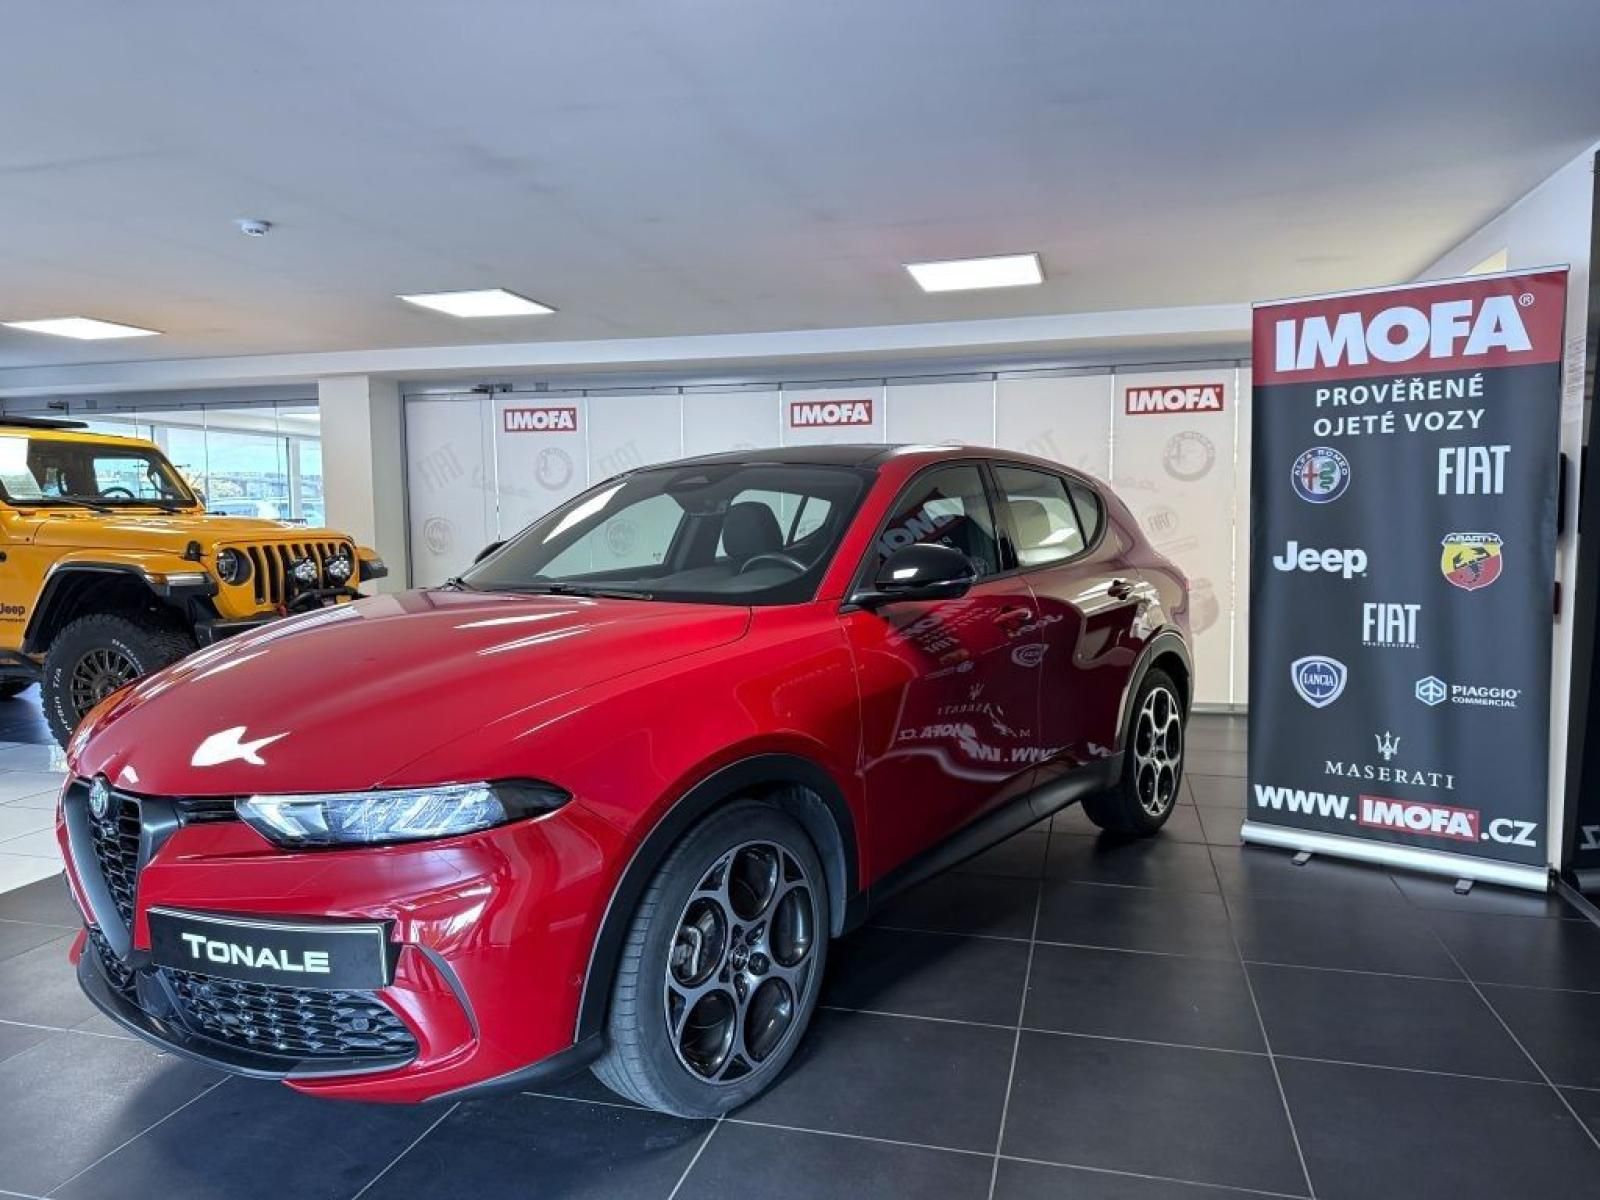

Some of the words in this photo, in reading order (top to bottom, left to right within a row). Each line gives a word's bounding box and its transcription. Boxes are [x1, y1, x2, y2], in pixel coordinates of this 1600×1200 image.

[1316, 373, 1484, 407] PROVĚŘENÉ
[1313, 410, 1395, 437] OJETÉ
[1404, 408, 1485, 432] VOZY
[1438, 445, 1511, 494] FIAT
[1273, 541, 1368, 578] Jeep
[1363, 602, 1421, 643] FIAT
[1451, 685, 1518, 699] PIAGGIO
[1324, 760, 1457, 790] MASERATI
[181, 932, 330, 974] TONALE
